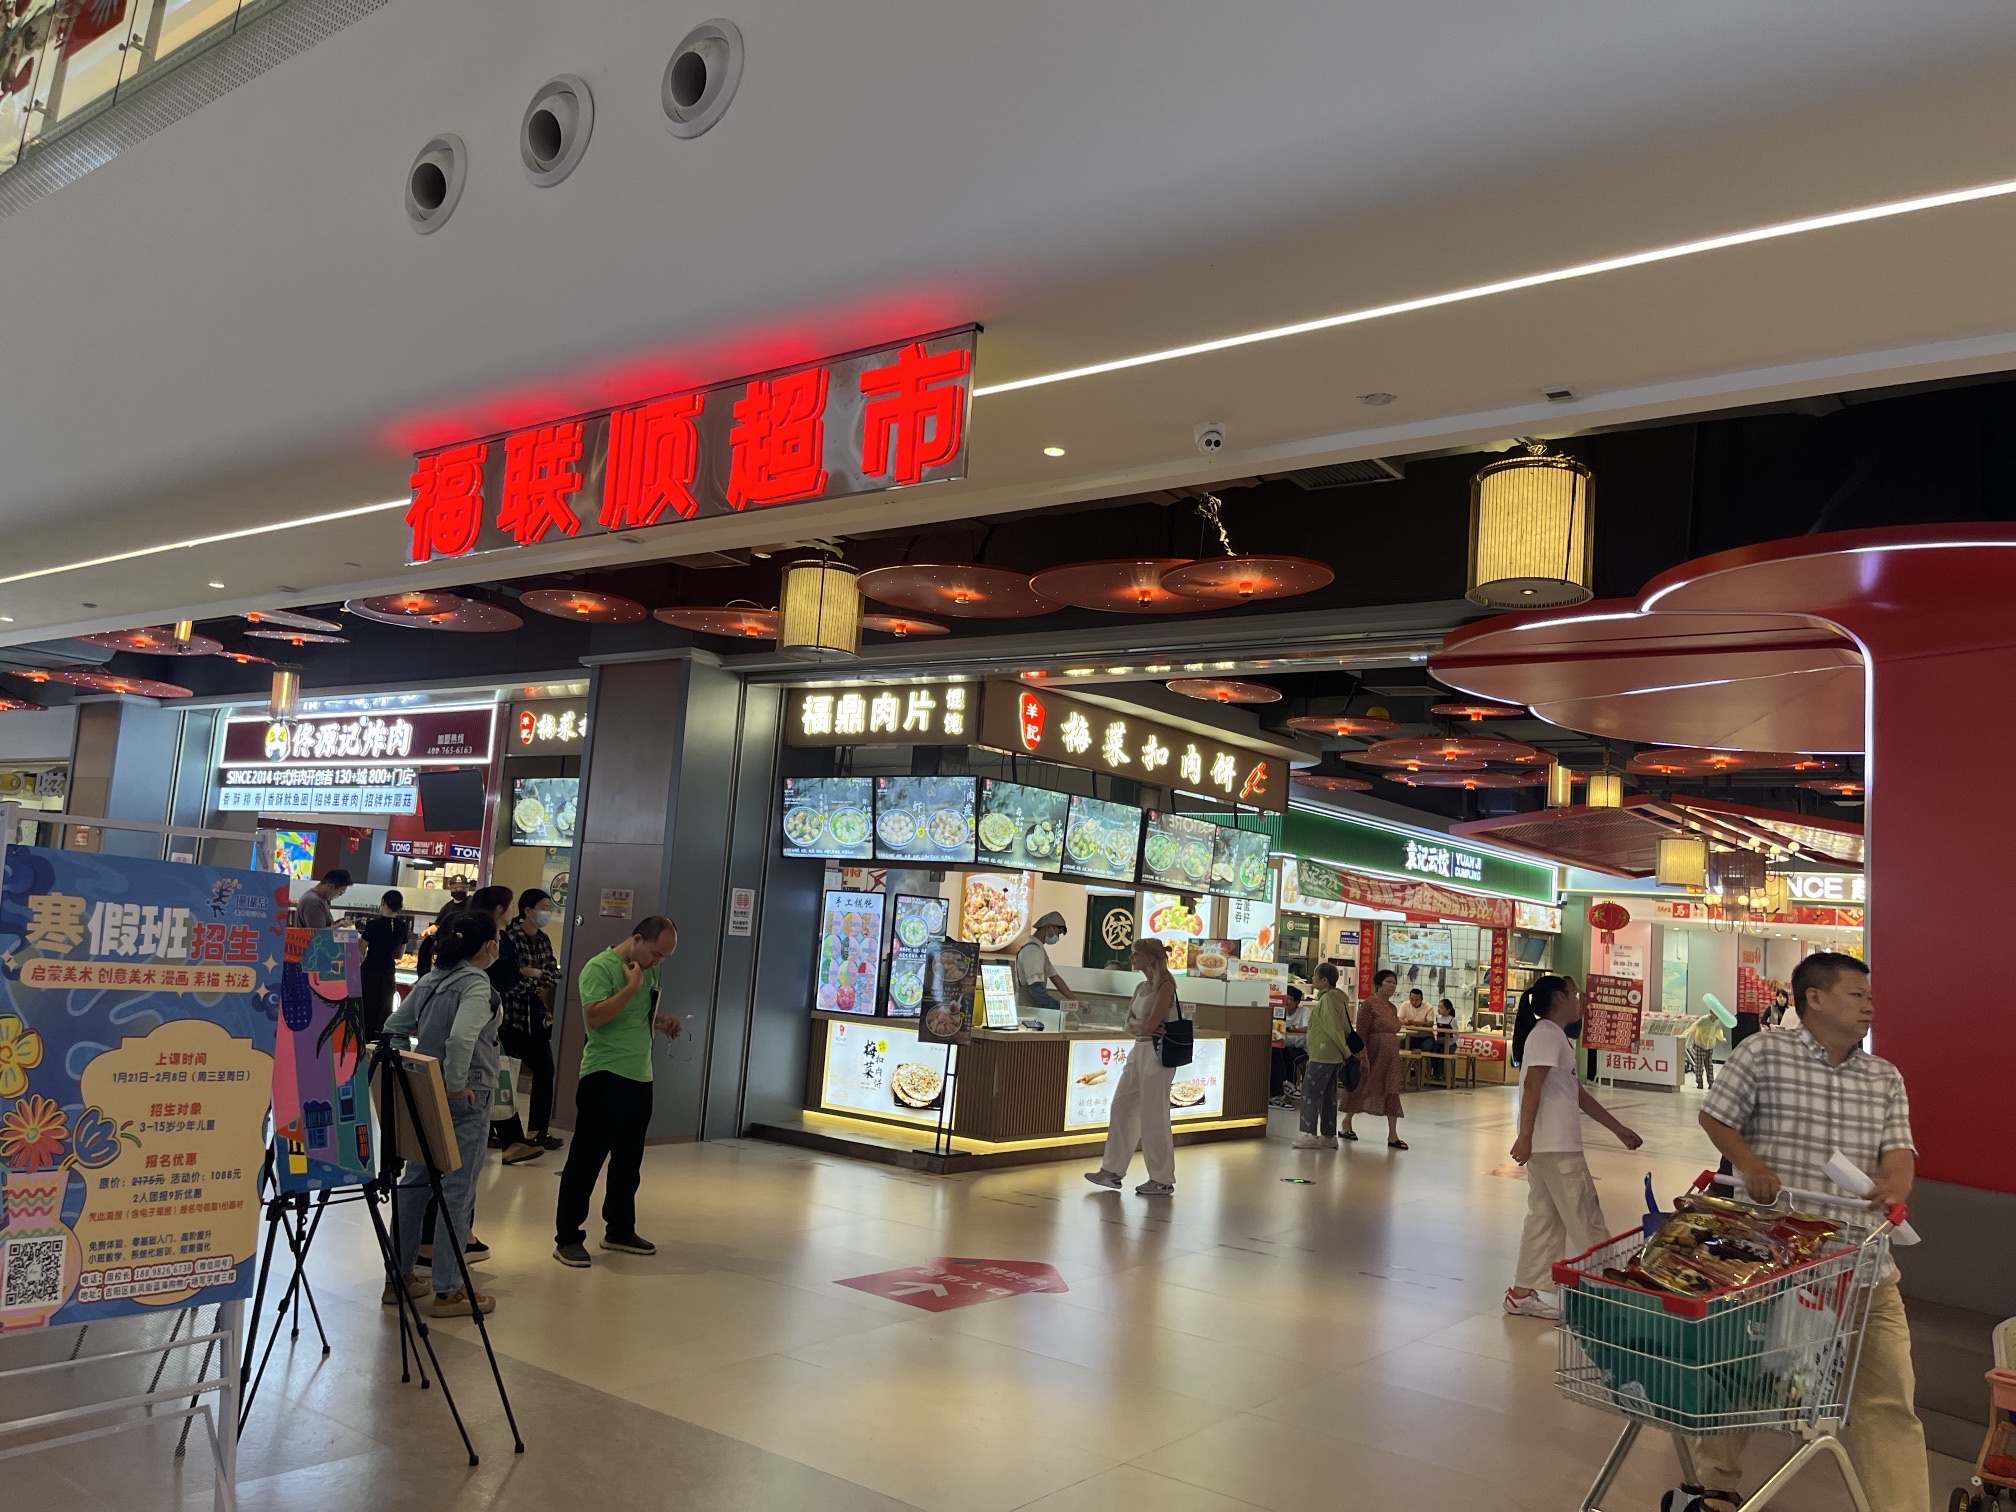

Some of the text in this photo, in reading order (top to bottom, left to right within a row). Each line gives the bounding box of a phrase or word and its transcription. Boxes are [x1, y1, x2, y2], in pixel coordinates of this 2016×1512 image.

[404, 342, 970, 561] 福联顺超市
[802, 691, 936, 734] 福鼎肉片
[292, 718, 413, 758] 佟源记炸肉
[1060, 711, 1236, 794] 梅菜扣肉饼
[314, 792, 359, 807] 招牌里脊肉
[391, 843, 410, 852] TONG
[434, 842, 444, 856] 炸
[1403, 840, 1450, 877] 袁记云饺
[1455, 853, 1475, 868] YUAN
[31, 965, 250, 988] 启蒙美术 创意美术 漫画 素描 书法
[155, 1052, 207, 1066] 上课时间
[1606, 1053, 1669, 1072] 超市入口
[150, 1102, 202, 1117] 招生对象
[139, 1119, 215, 1133] 3-15岁少年儿童
[145, 1152, 197, 1168] 报名优惠
[133, 1188, 202, 1203] 2人团报9折优惠
[135, 1267, 149, 1279] 188
